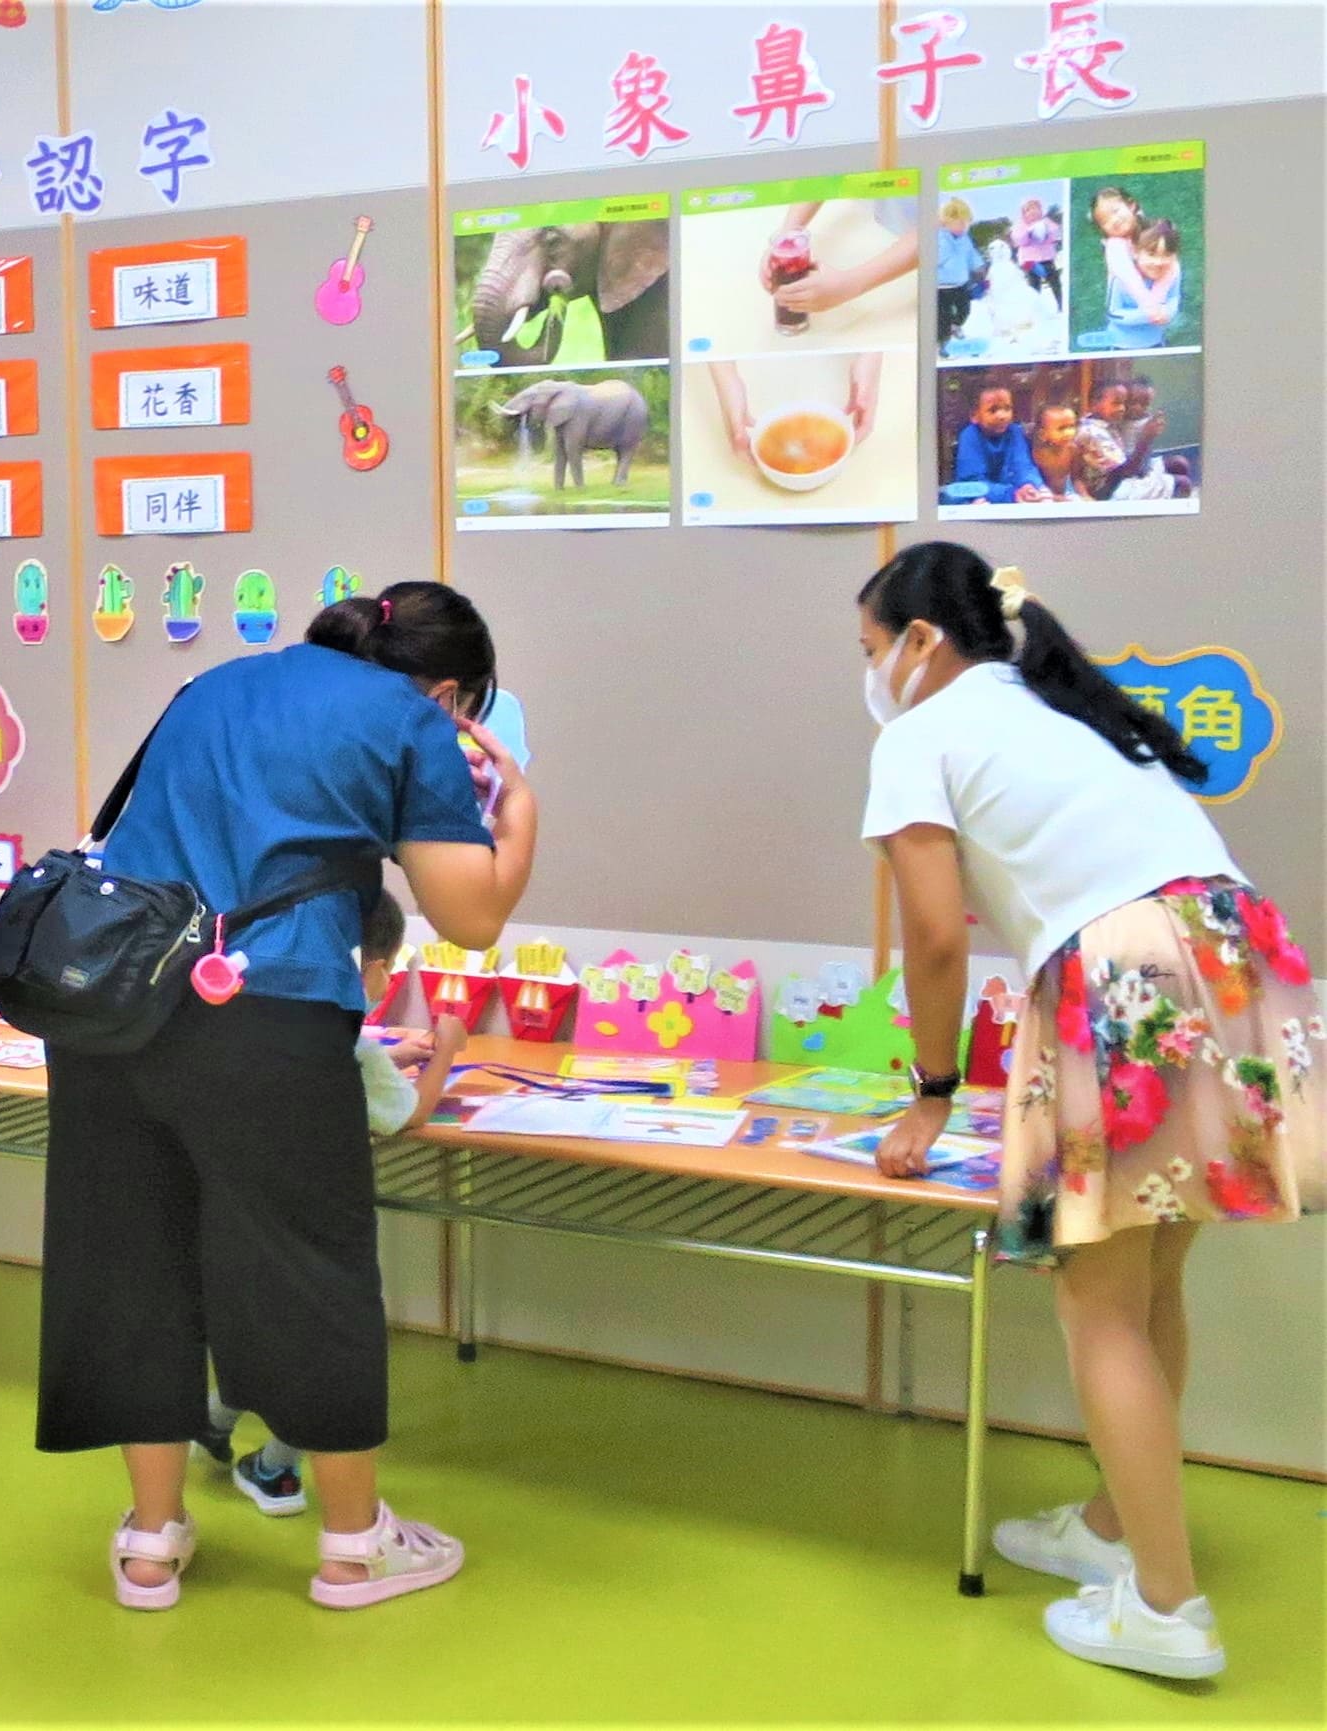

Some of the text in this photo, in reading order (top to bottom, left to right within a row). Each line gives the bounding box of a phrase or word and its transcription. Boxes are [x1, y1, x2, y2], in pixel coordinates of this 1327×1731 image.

[481, 0, 1130, 168] 小象鼻子長
[132, 272, 193, 309] 味道
[140, 383, 201, 418] 花香
[145, 489, 203, 525] 同伴
